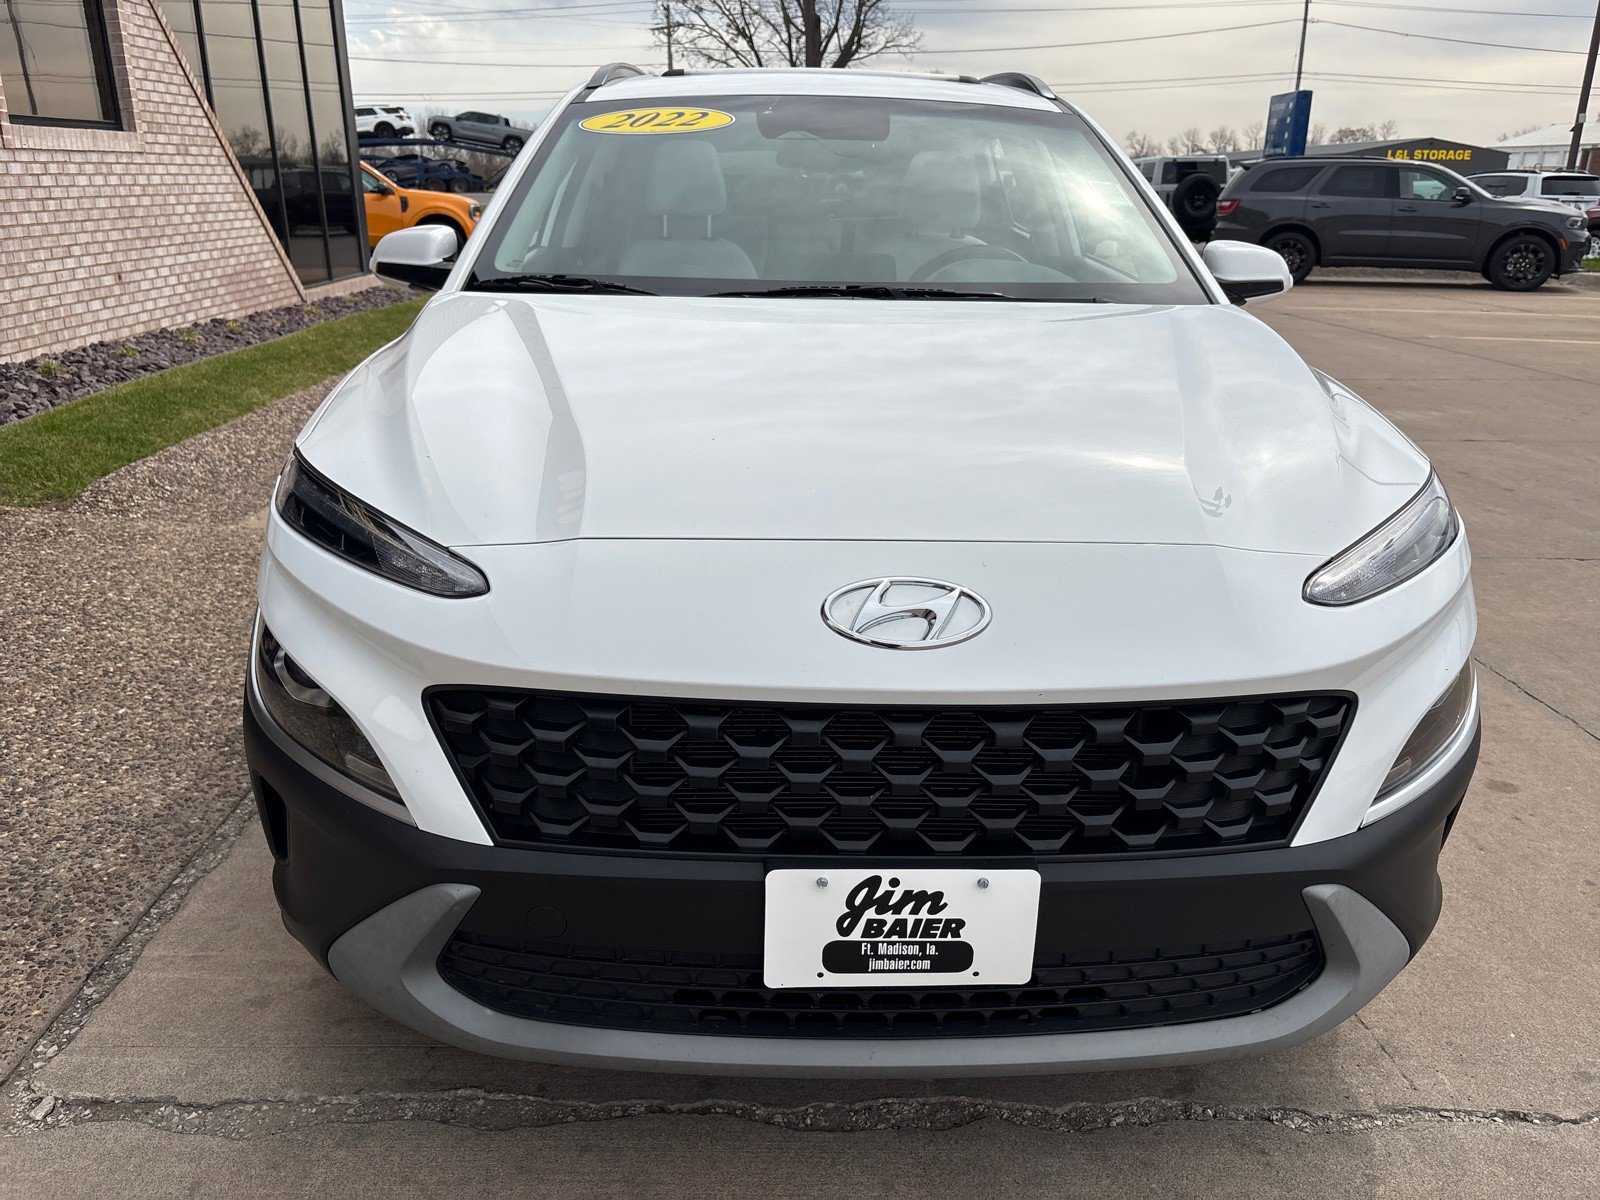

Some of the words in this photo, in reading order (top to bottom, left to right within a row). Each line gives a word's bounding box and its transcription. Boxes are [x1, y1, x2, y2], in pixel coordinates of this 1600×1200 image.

[601, 112, 709, 128] 2022
[1387, 149, 1410, 160] L&L
[1413, 149, 1472, 160] STORAGE
[836, 875, 948, 937] Jim
[860, 918, 966, 939] BAIER
[861, 943, 874, 956] Ft.
[878, 942, 922, 957] Madison,
[926, 943, 939, 956] Ia.
[868, 958, 931, 972] jimbaier.com
